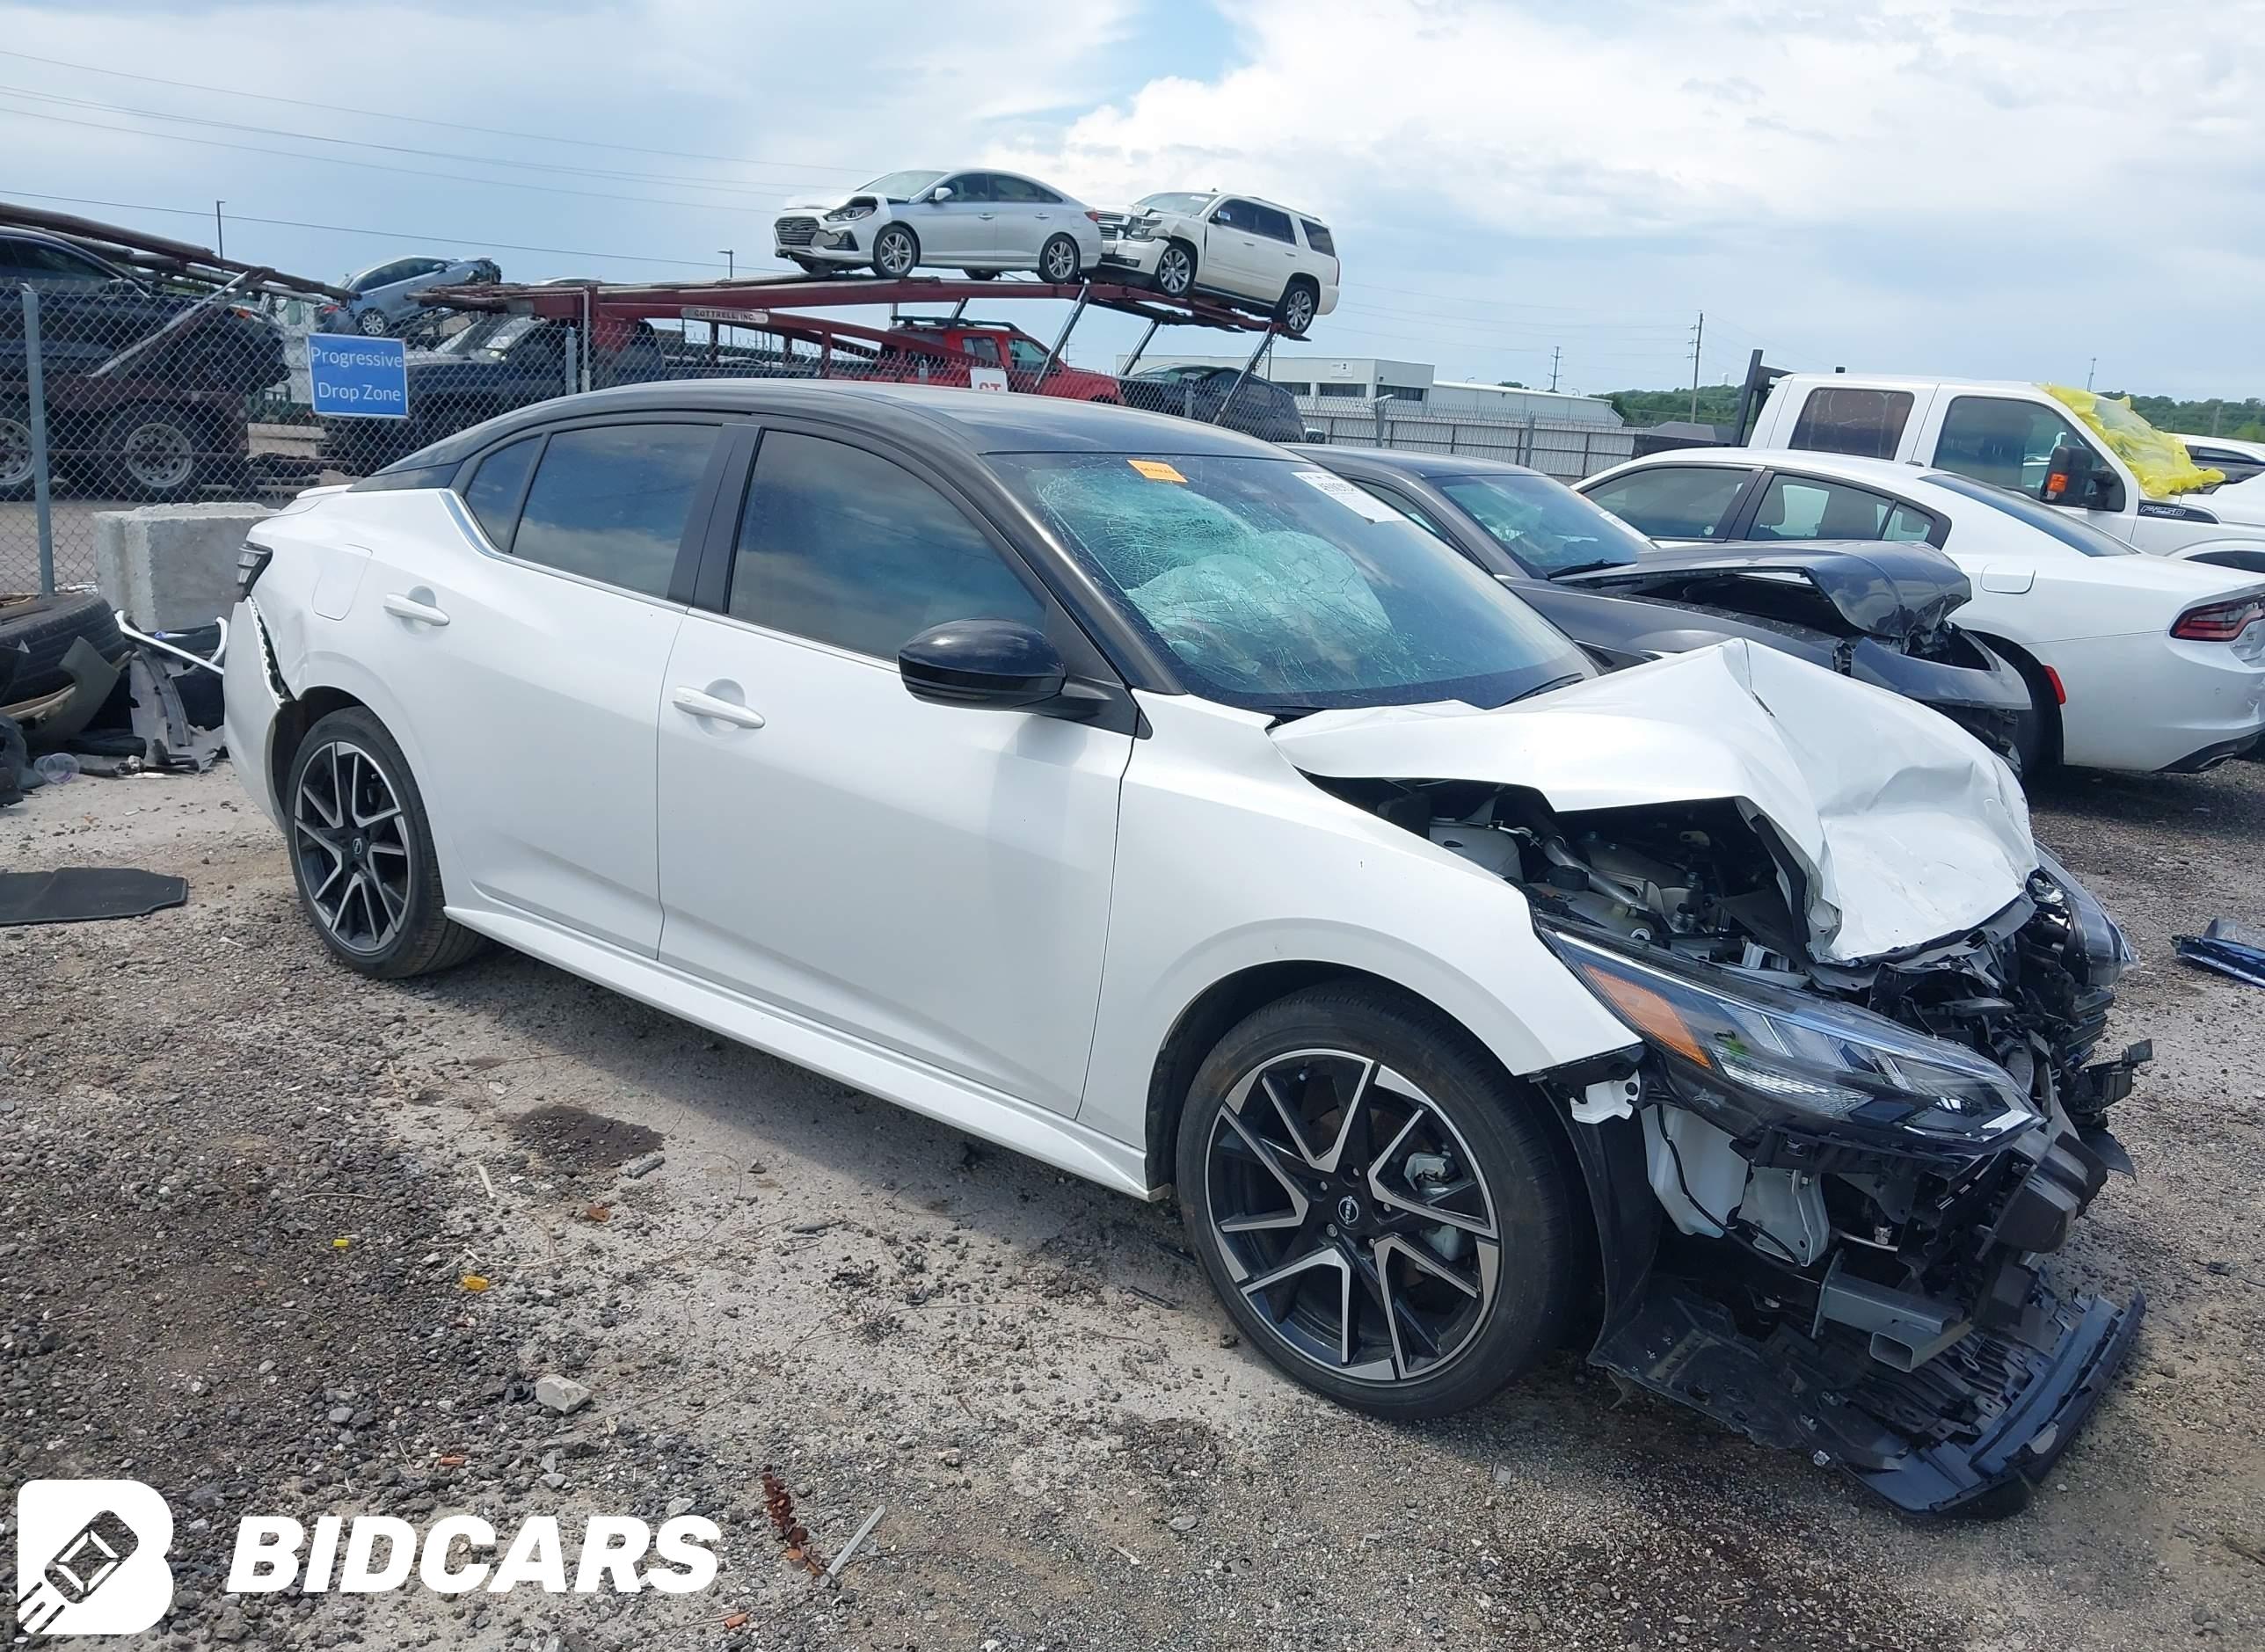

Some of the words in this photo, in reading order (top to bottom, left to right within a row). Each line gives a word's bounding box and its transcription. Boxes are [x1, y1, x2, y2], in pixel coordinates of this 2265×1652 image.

[310, 346, 403, 368] Progressive
[317, 382, 360, 403] Drop
[362, 384, 402, 402] Zone
